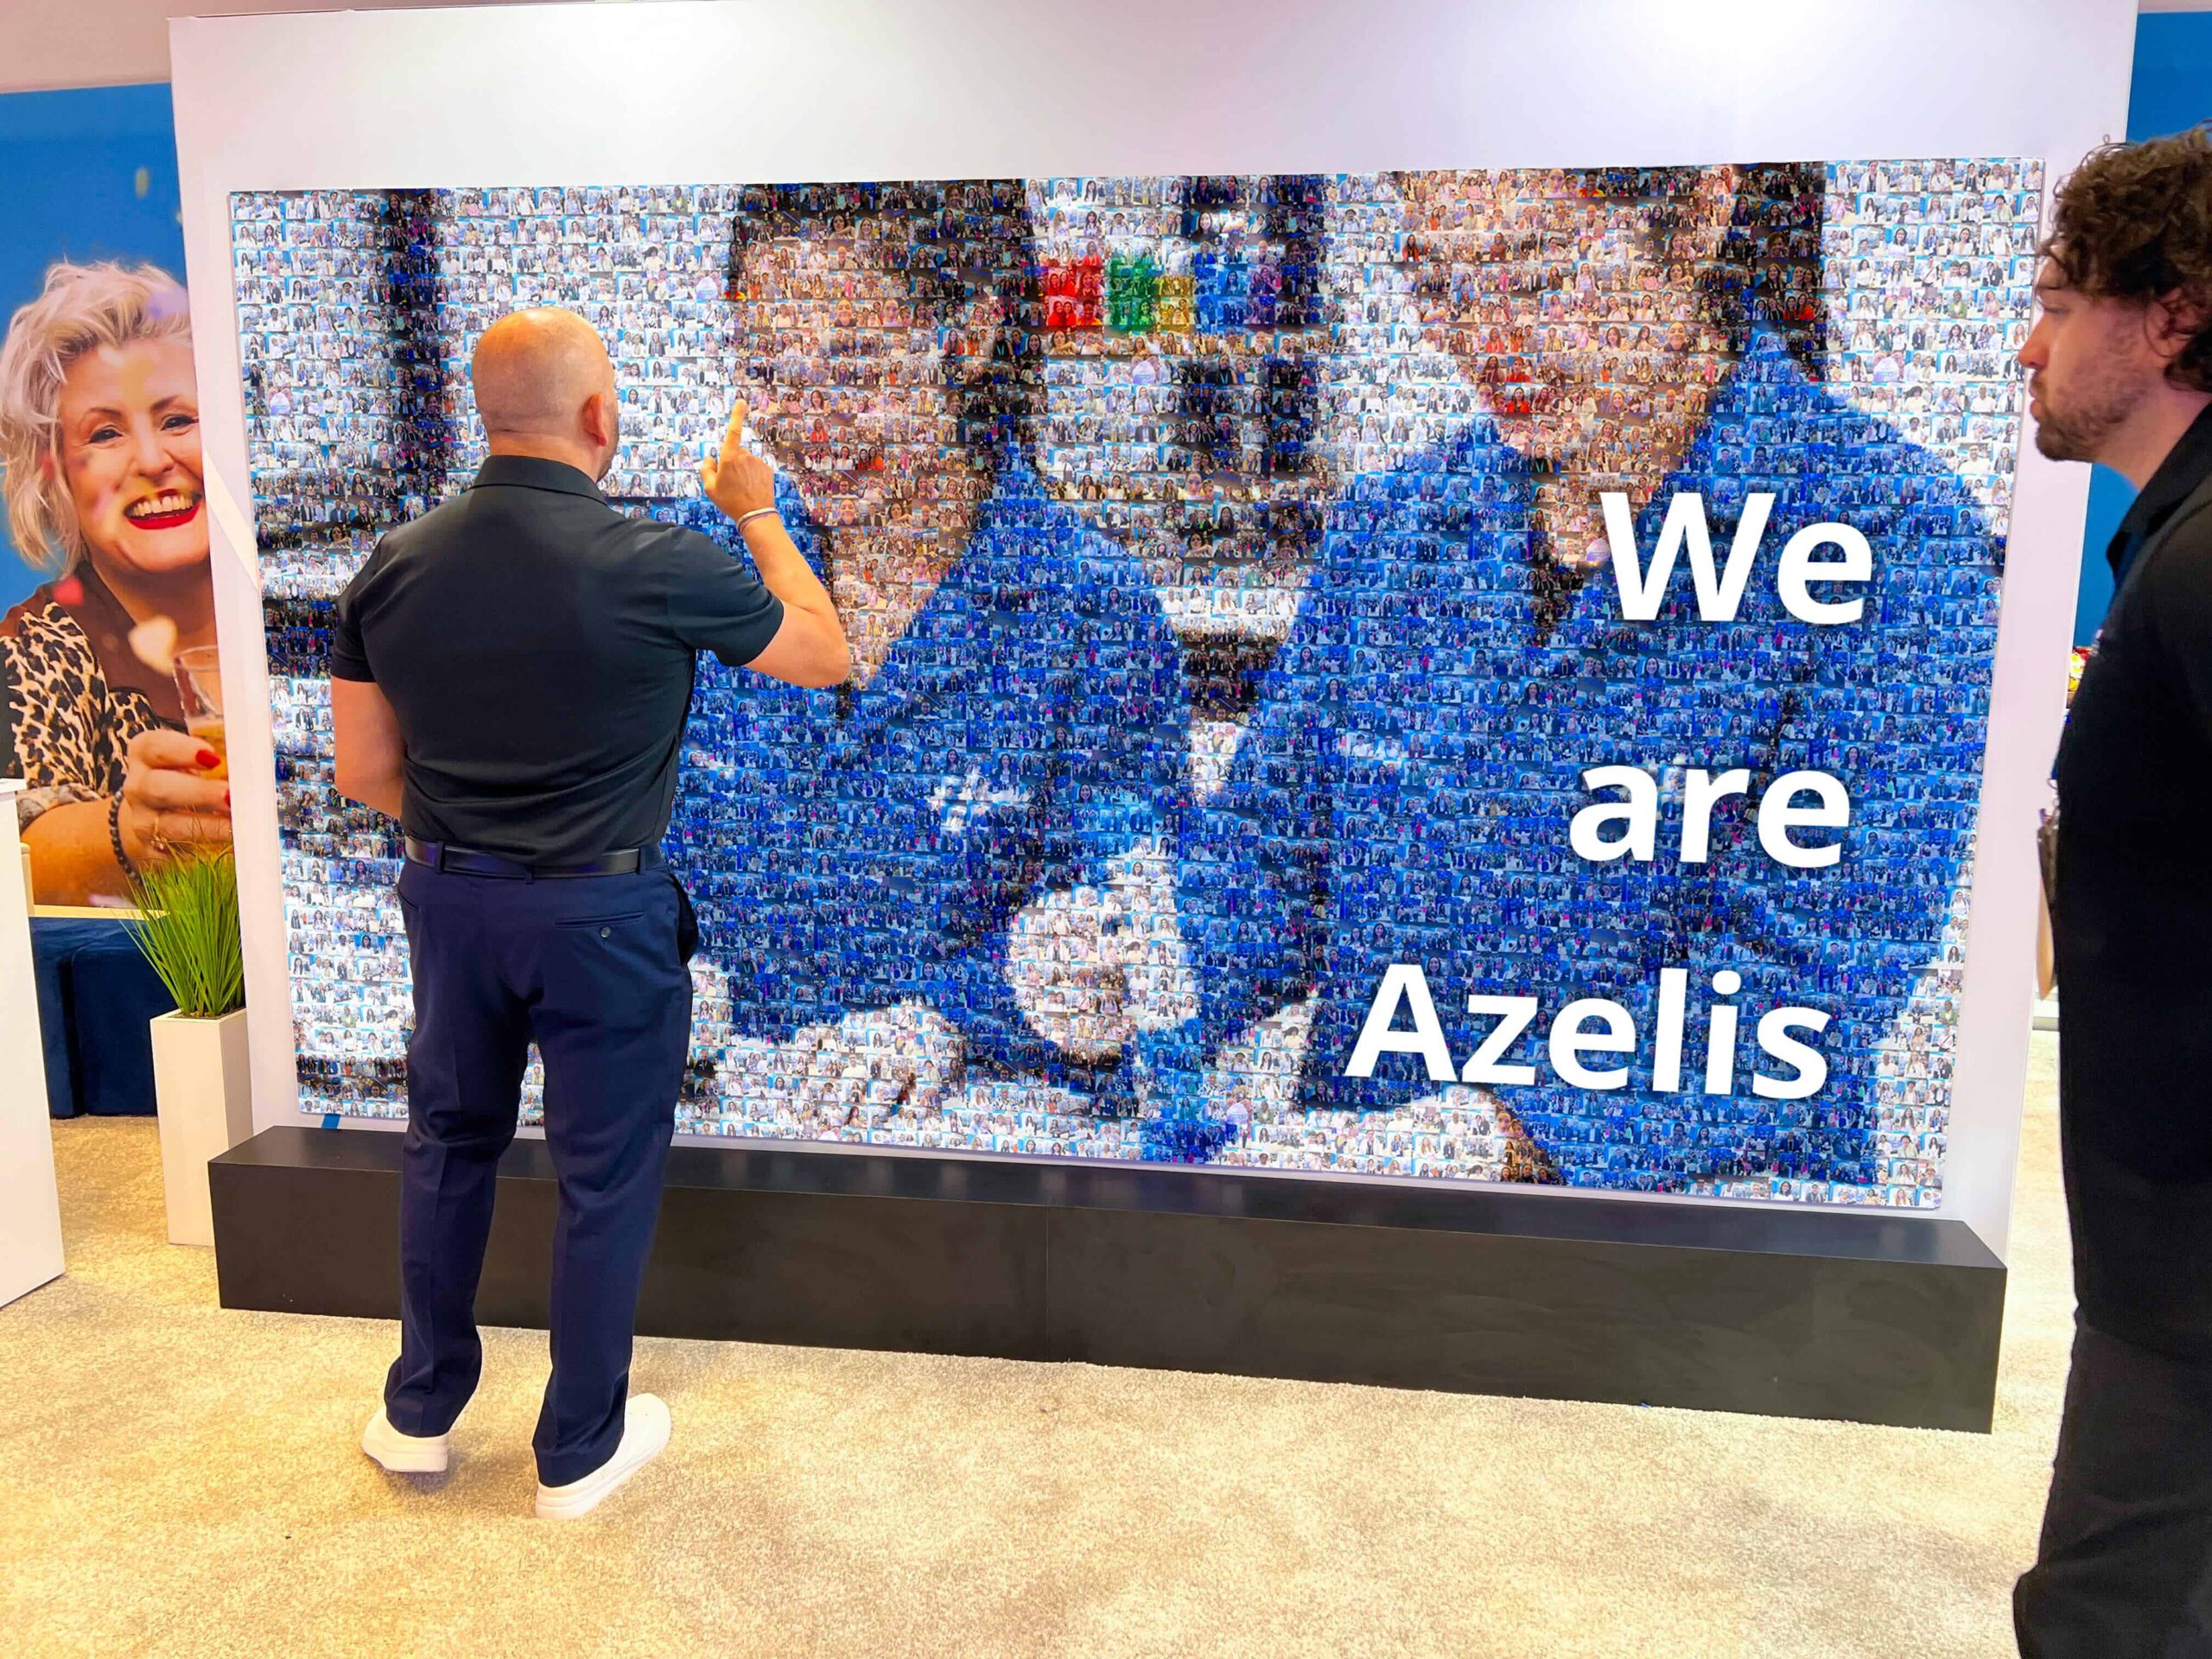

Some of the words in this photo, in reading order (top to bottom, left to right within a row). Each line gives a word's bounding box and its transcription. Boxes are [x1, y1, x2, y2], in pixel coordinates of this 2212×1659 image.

[1600, 492, 1873, 625] We
[1569, 764, 1851, 868] are
[1344, 963, 1832, 1099] Azelis
